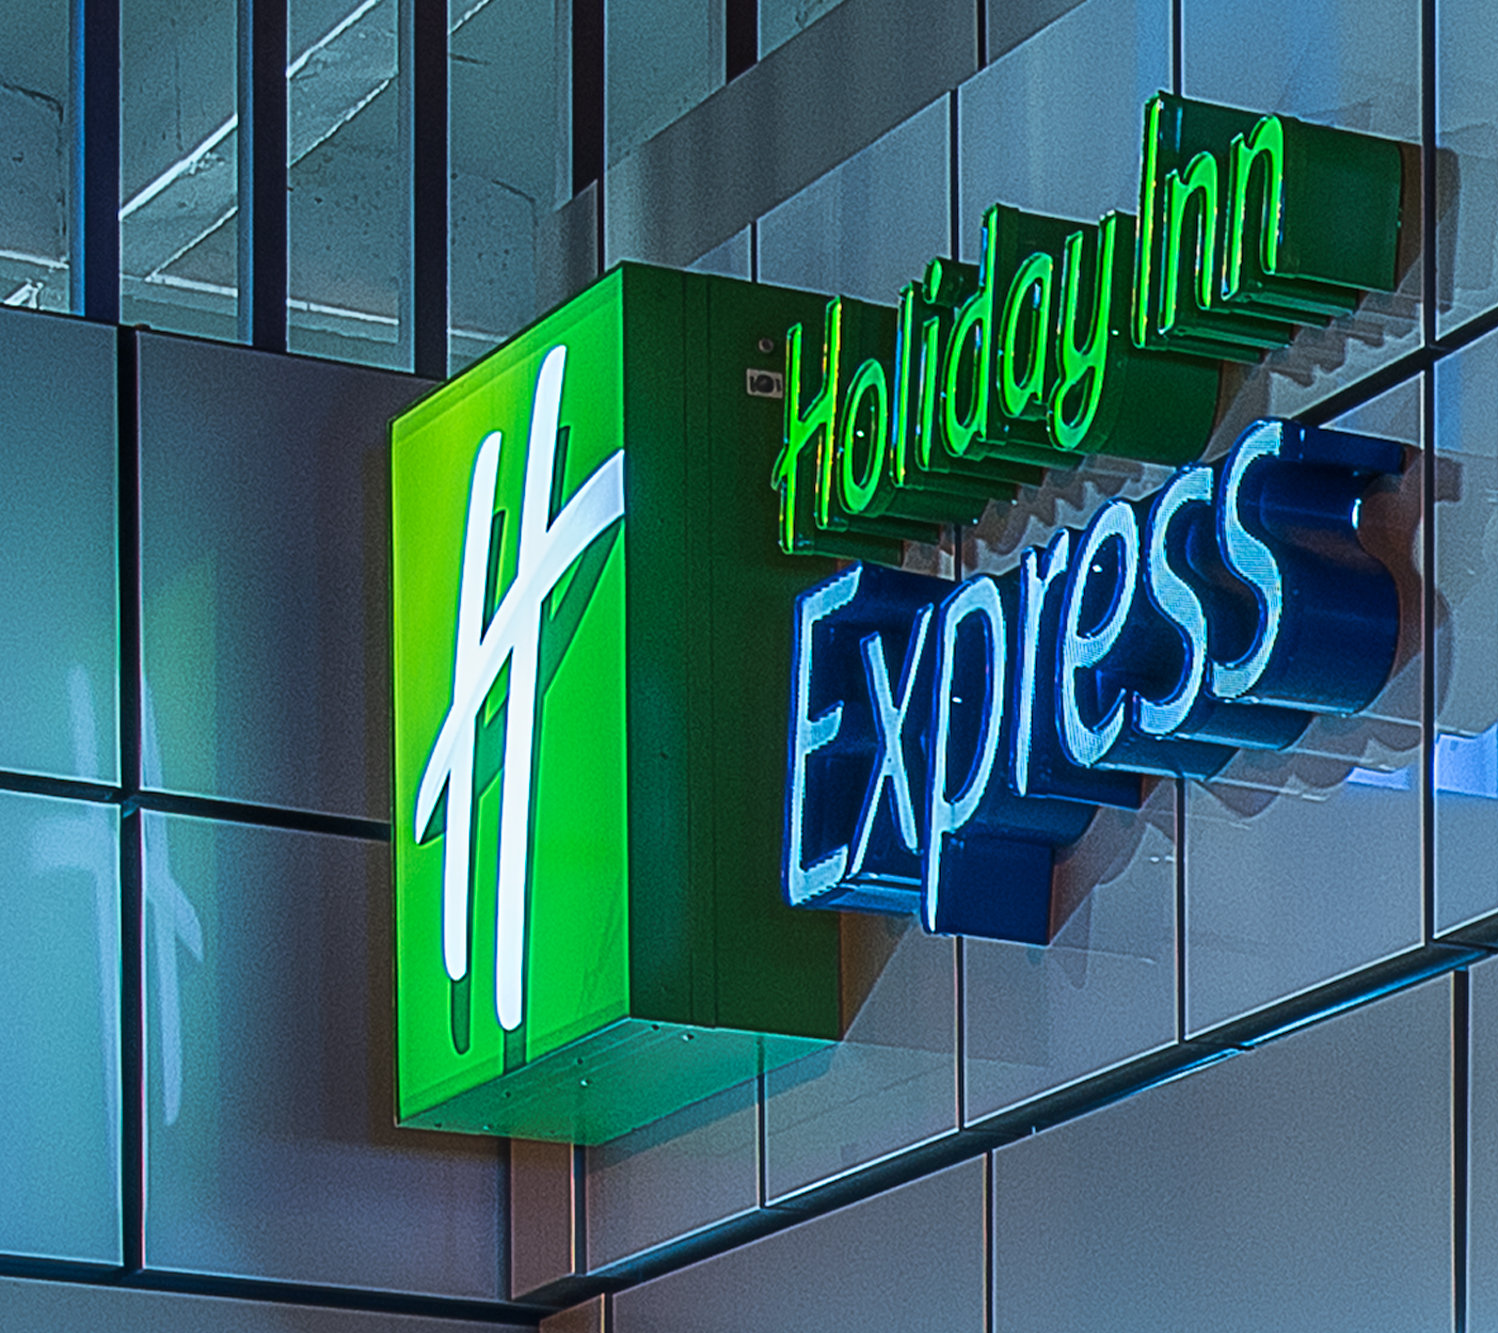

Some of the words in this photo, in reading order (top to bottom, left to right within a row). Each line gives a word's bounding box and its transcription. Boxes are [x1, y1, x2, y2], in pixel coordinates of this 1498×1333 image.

[772, 203, 1116, 554] Holiday
[1132, 92, 1283, 348] Inn
[783, 419, 1284, 934] Express
